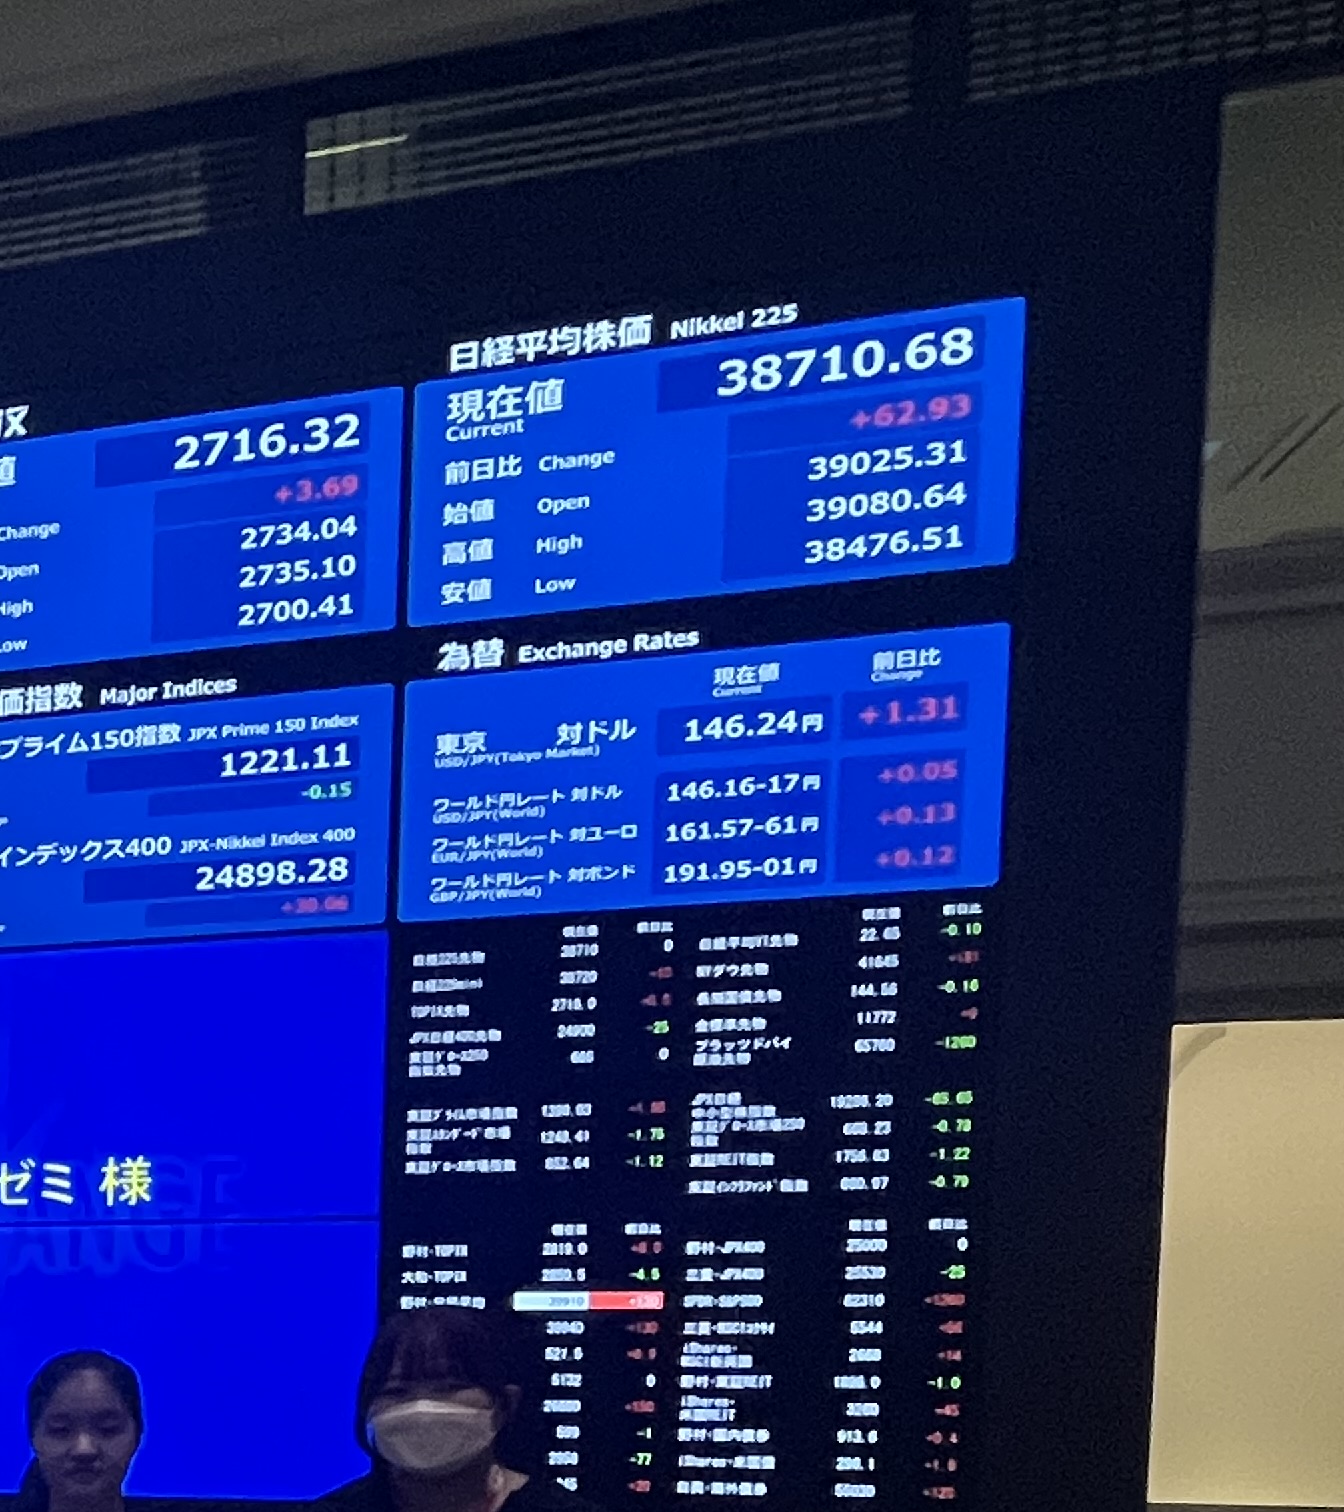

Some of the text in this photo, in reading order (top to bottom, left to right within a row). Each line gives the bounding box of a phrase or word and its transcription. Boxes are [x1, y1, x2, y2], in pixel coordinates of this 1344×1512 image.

[449, 304, 798, 374] 日経平均株価 Nikkei 225
[717, 327, 974, 396] 38710.68
[446, 378, 564, 425] 現在値
[851, 393, 972, 430] +62.93
[174, 414, 360, 471] 2716.32
[446, 418, 525, 442] Current
[445, 448, 615, 485] 前日比 Change
[808, 440, 967, 481] 39025.31
[275, 474, 359, 503] +3.69
[806, 482, 967, 522] 39080.64
[443, 493, 590, 525] 始値 Open
[240, 516, 358, 551] 2734.04
[442, 533, 582, 566] 高値 High
[805, 525, 963, 564] 38476.51
[239, 555, 356, 589] 2735.10
[535, 576, 576, 595] Low
[238, 594, 353, 626] 2700.41
[437, 629, 699, 672] 為替 Exchange Rates
[872, 648, 942, 672] 前日比
[714, 662, 780, 686] 現在値
[100, 684, 156, 707] Major
[162, 676, 237, 698] Indices
[858, 696, 958, 726] +1.31
[187, 724, 217, 742] JPX
[222, 720, 269, 738] Prime
[274, 719, 304, 734] 150
[311, 714, 358, 730] Index
[436, 719, 636, 756] 東京 対ドル
[220, 743, 351, 778] 1221.11
[878, 760, 958, 783] +0.05
[301, 782, 352, 801] -0.15
[434, 784, 623, 814] ワールド円レート 対ドル
[179, 832, 266, 855] JPX-Nikkei
[270, 828, 318, 847] Index
[323, 827, 355, 843] 400
[432, 824, 637, 854] ワールド円レート 対ユーロ
[195, 858, 348, 892] 24898.28
[431, 869, 562, 894] ワールド円レート
[100, 1155, 153, 1205] 様
